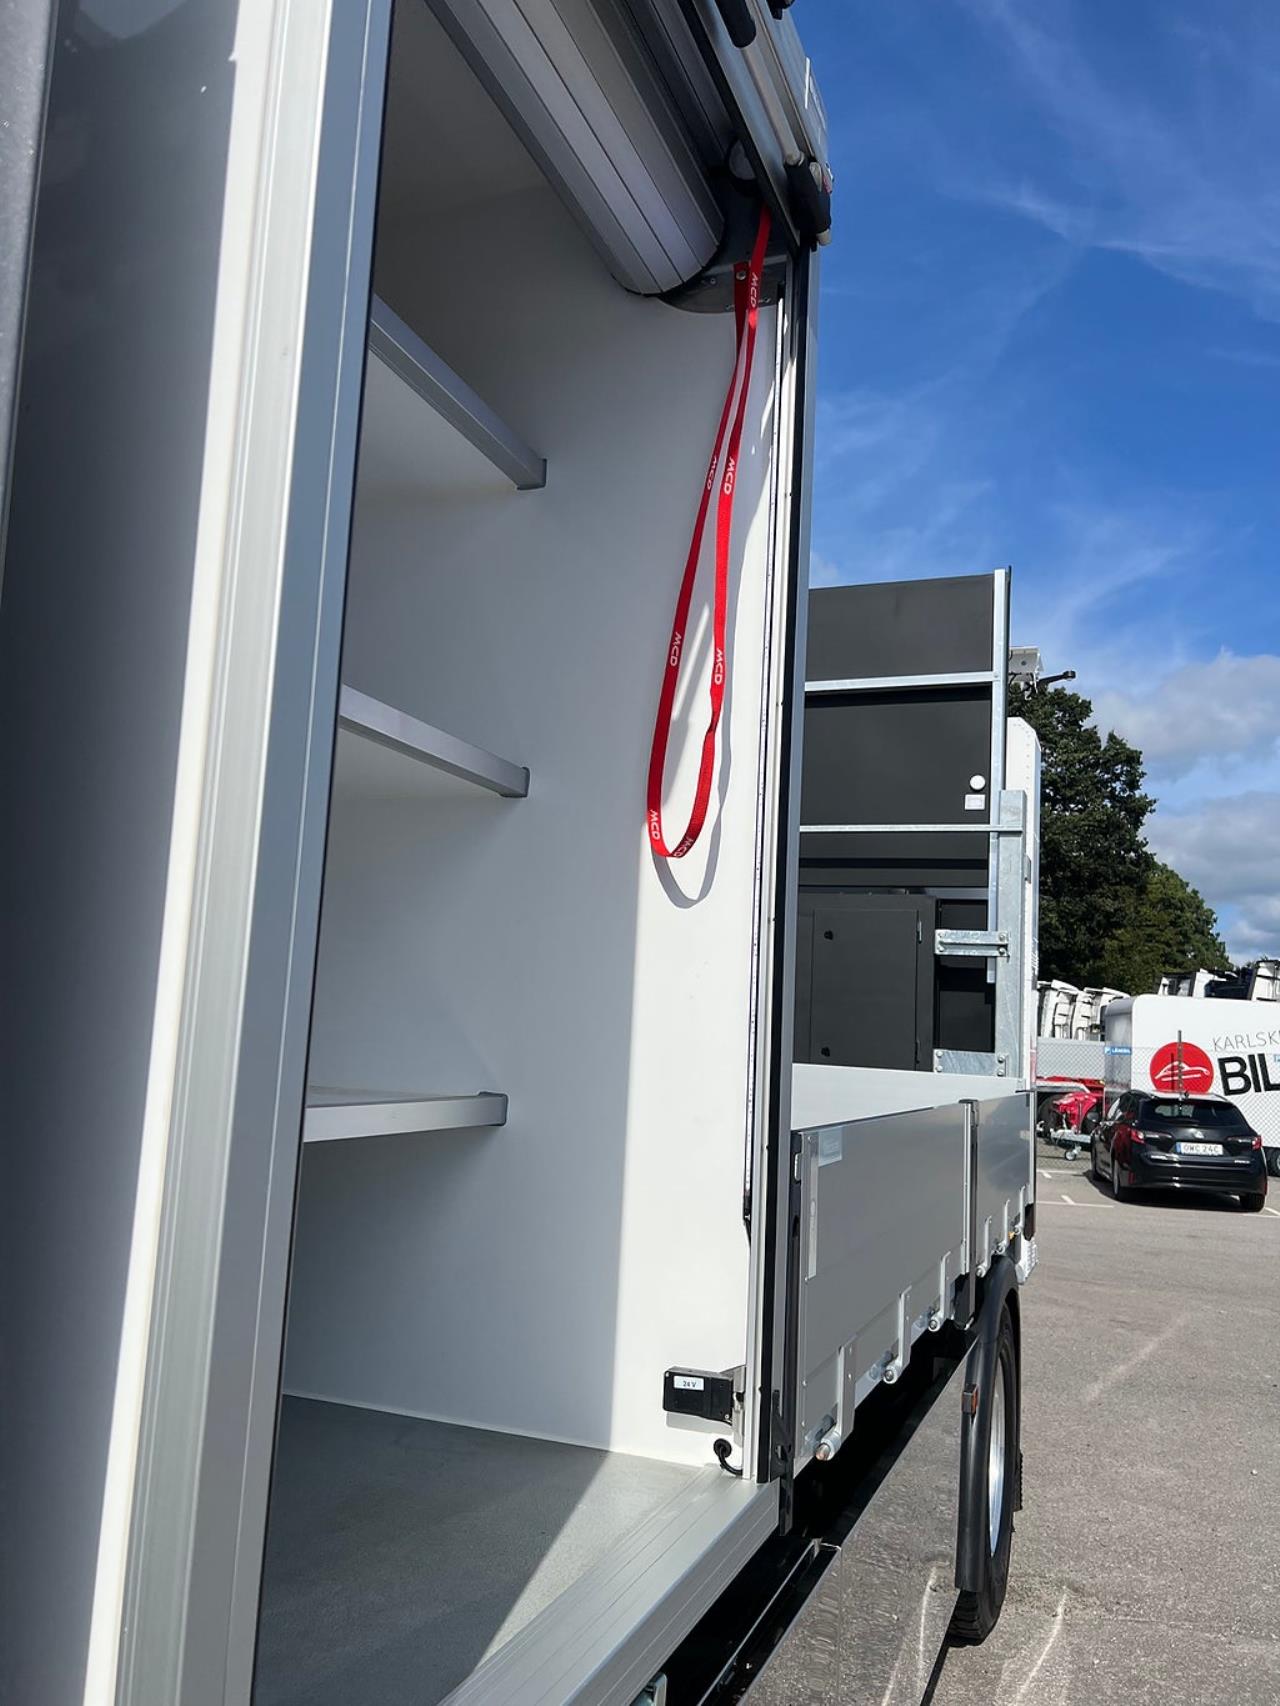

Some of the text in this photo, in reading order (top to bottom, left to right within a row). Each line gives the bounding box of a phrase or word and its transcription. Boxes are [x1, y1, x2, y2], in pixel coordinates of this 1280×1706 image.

[750, 272, 759, 308] MCD
[724, 456, 736, 495] MCD
[670, 631, 682, 667] MCD
[714, 647, 724, 685] MCD
[650, 809, 660, 840] MCD
[1213, 1030, 1280, 1051] KARLSK
